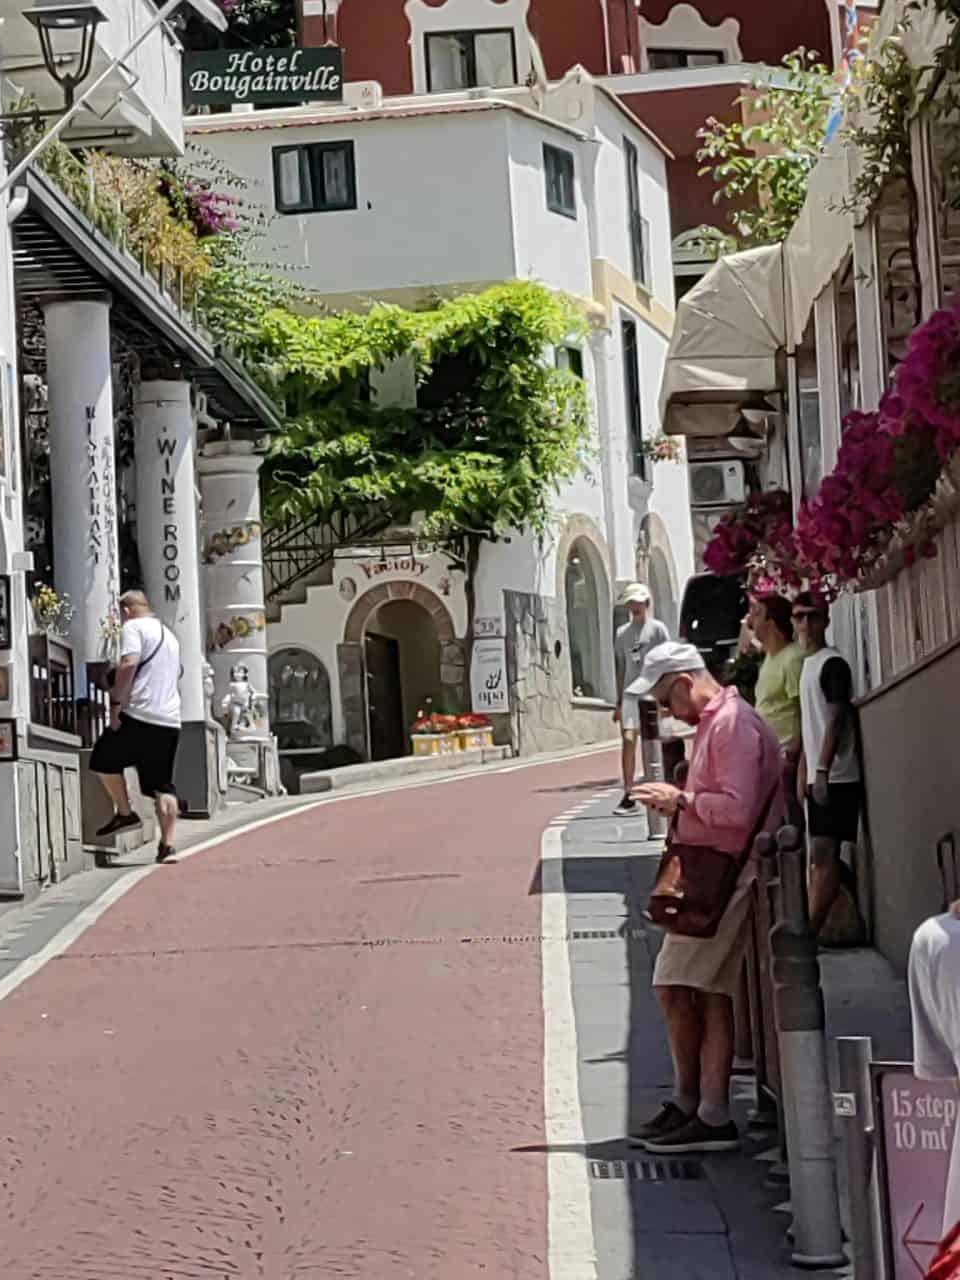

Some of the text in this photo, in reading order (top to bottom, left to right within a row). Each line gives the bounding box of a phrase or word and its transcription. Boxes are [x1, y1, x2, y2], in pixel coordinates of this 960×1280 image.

[226, 50, 303, 73] Hotel
[190, 66, 340, 99] Bougainville
[157, 438, 182, 602] WINE ROOM
[891, 1088, 913, 1118] 15
[894, 1121, 917, 1150] 10
